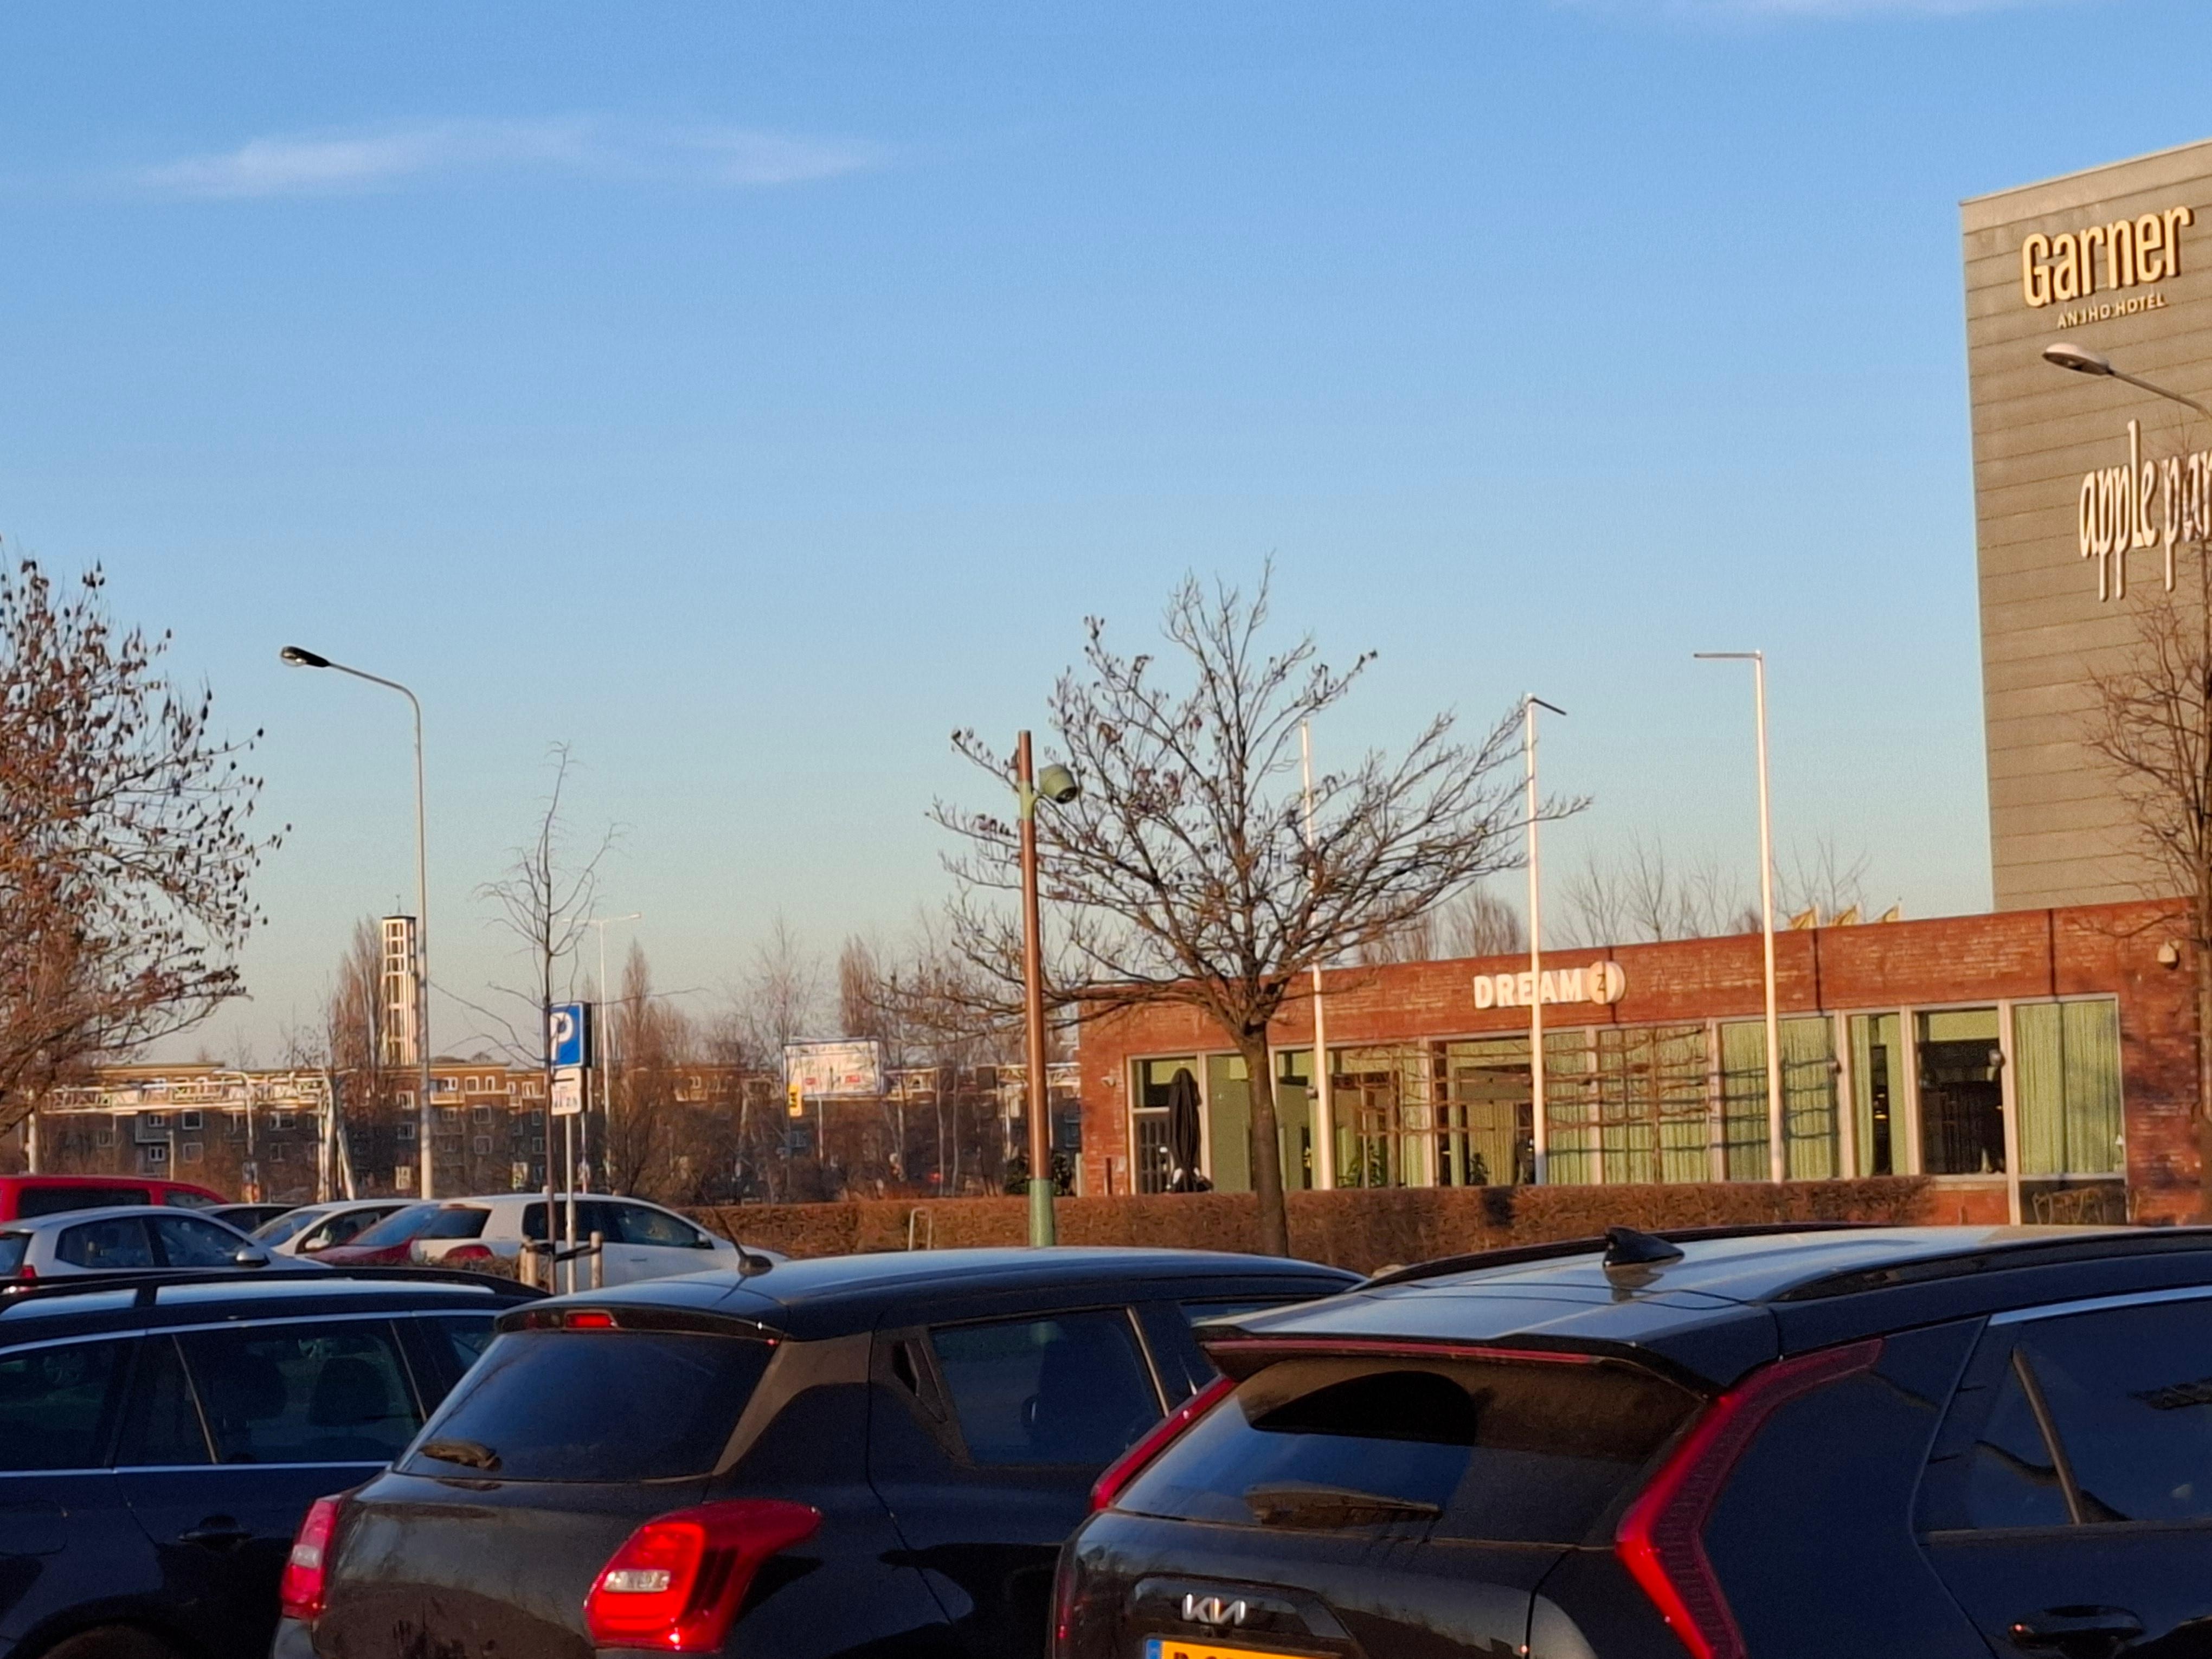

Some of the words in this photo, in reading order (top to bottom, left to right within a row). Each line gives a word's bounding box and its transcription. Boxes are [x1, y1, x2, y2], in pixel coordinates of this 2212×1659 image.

[2022, 205, 2192, 308] Garner
[2057, 309, 2078, 329] AN
[2115, 292, 2166, 316] HOTEL
[2079, 419, 2159, 601] apple
[1474, 968, 1582, 1009] DREAM
[550, 1012, 573, 1061] P
[1181, 1593, 1246, 1625] KIA
